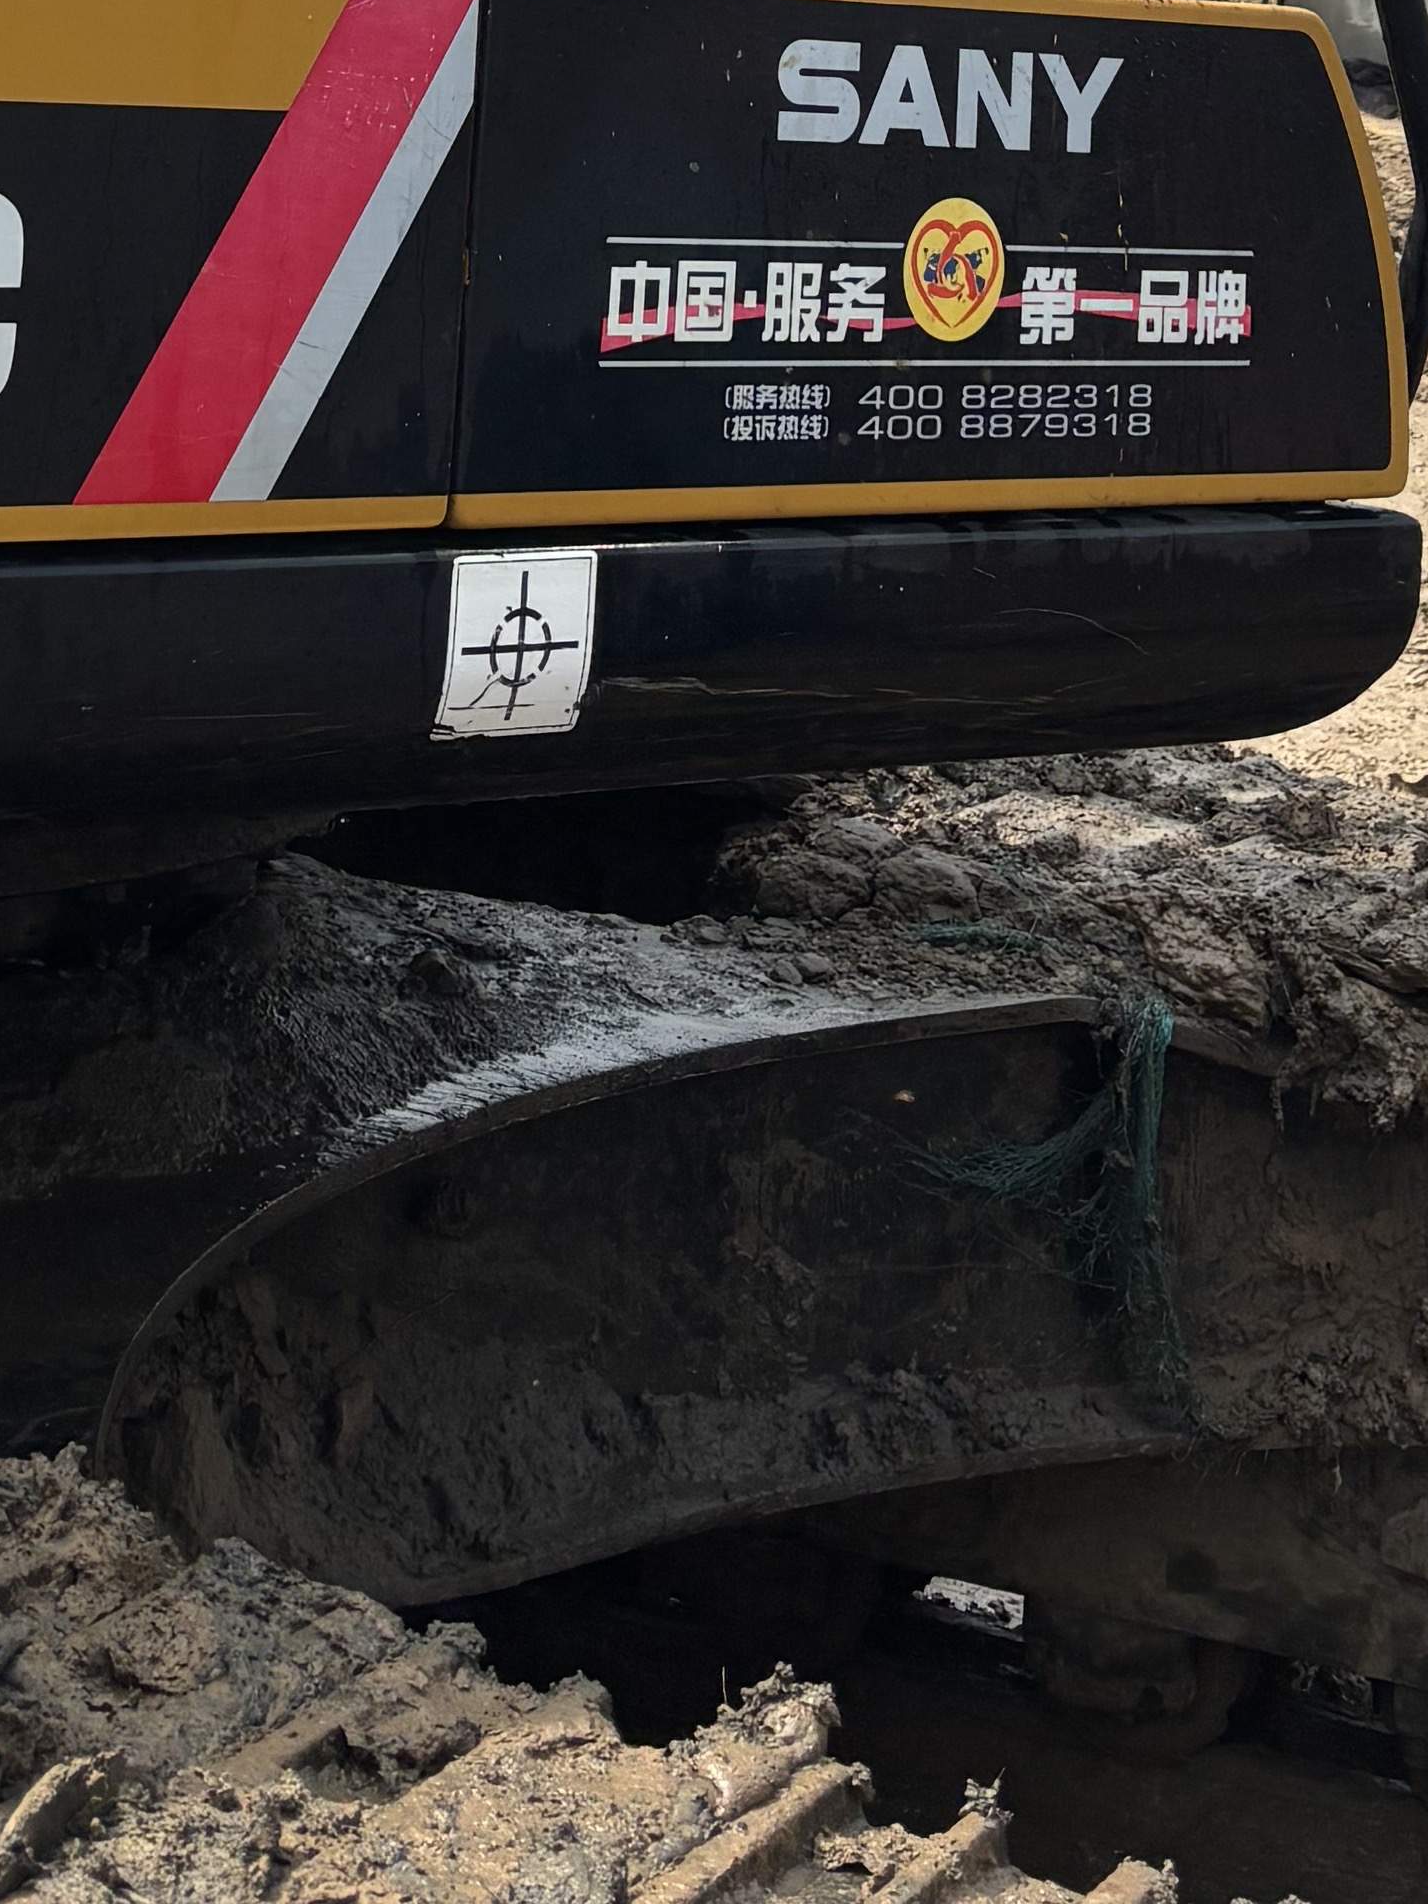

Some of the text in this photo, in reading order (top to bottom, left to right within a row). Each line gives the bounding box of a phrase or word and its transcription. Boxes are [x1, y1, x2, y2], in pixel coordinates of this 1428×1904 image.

[777, 39, 1124, 153] SANY
[1019, 266, 1247, 345] 第一品牌
[858, 384, 943, 410] 400
[961, 384, 1152, 409] 8282318
[857, 414, 942, 440] 400
[960, 413, 1151, 439] 8879318
